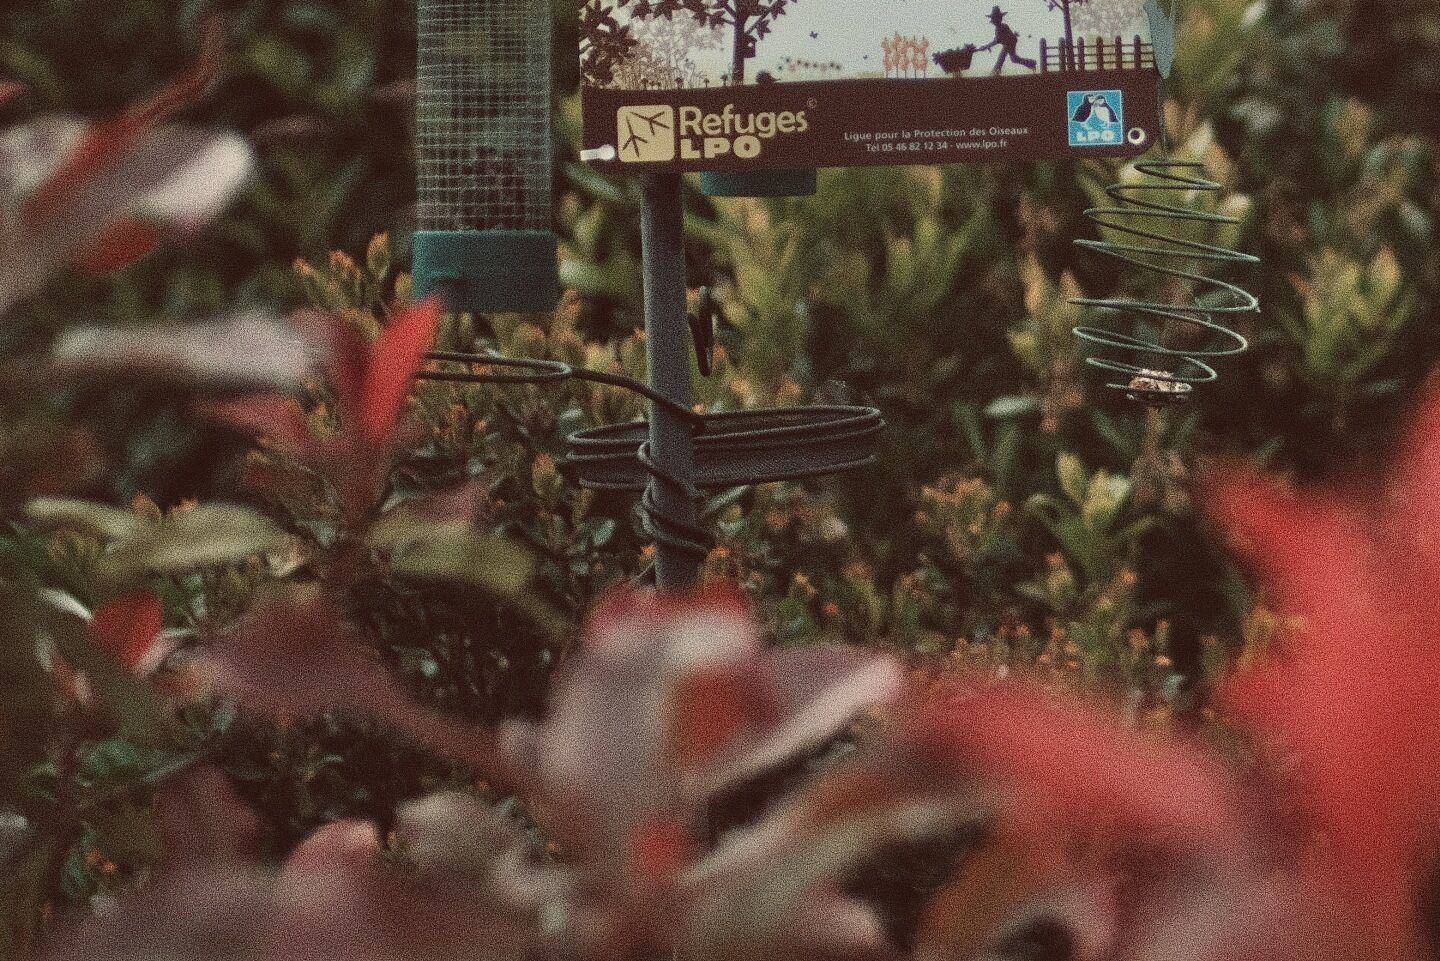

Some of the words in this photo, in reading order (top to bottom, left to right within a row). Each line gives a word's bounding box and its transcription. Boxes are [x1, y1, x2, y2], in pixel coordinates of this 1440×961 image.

[844, 131, 872, 142] Ligue
[874, 131, 899, 141] pour
[901, 130, 911, 139] la
[914, 128, 966, 138] Protection
[969, 127, 986, 137] des
[989, 126, 1028, 136] Oiseaux
[1076, 130, 1114, 142] LPO
[681, 135, 761, 159] LPO
[881, 143, 893, 152] 05
[923, 141, 934, 150] 12
[936, 141, 948, 150] 34
[955, 140, 1008, 149] www.lpo.fr
